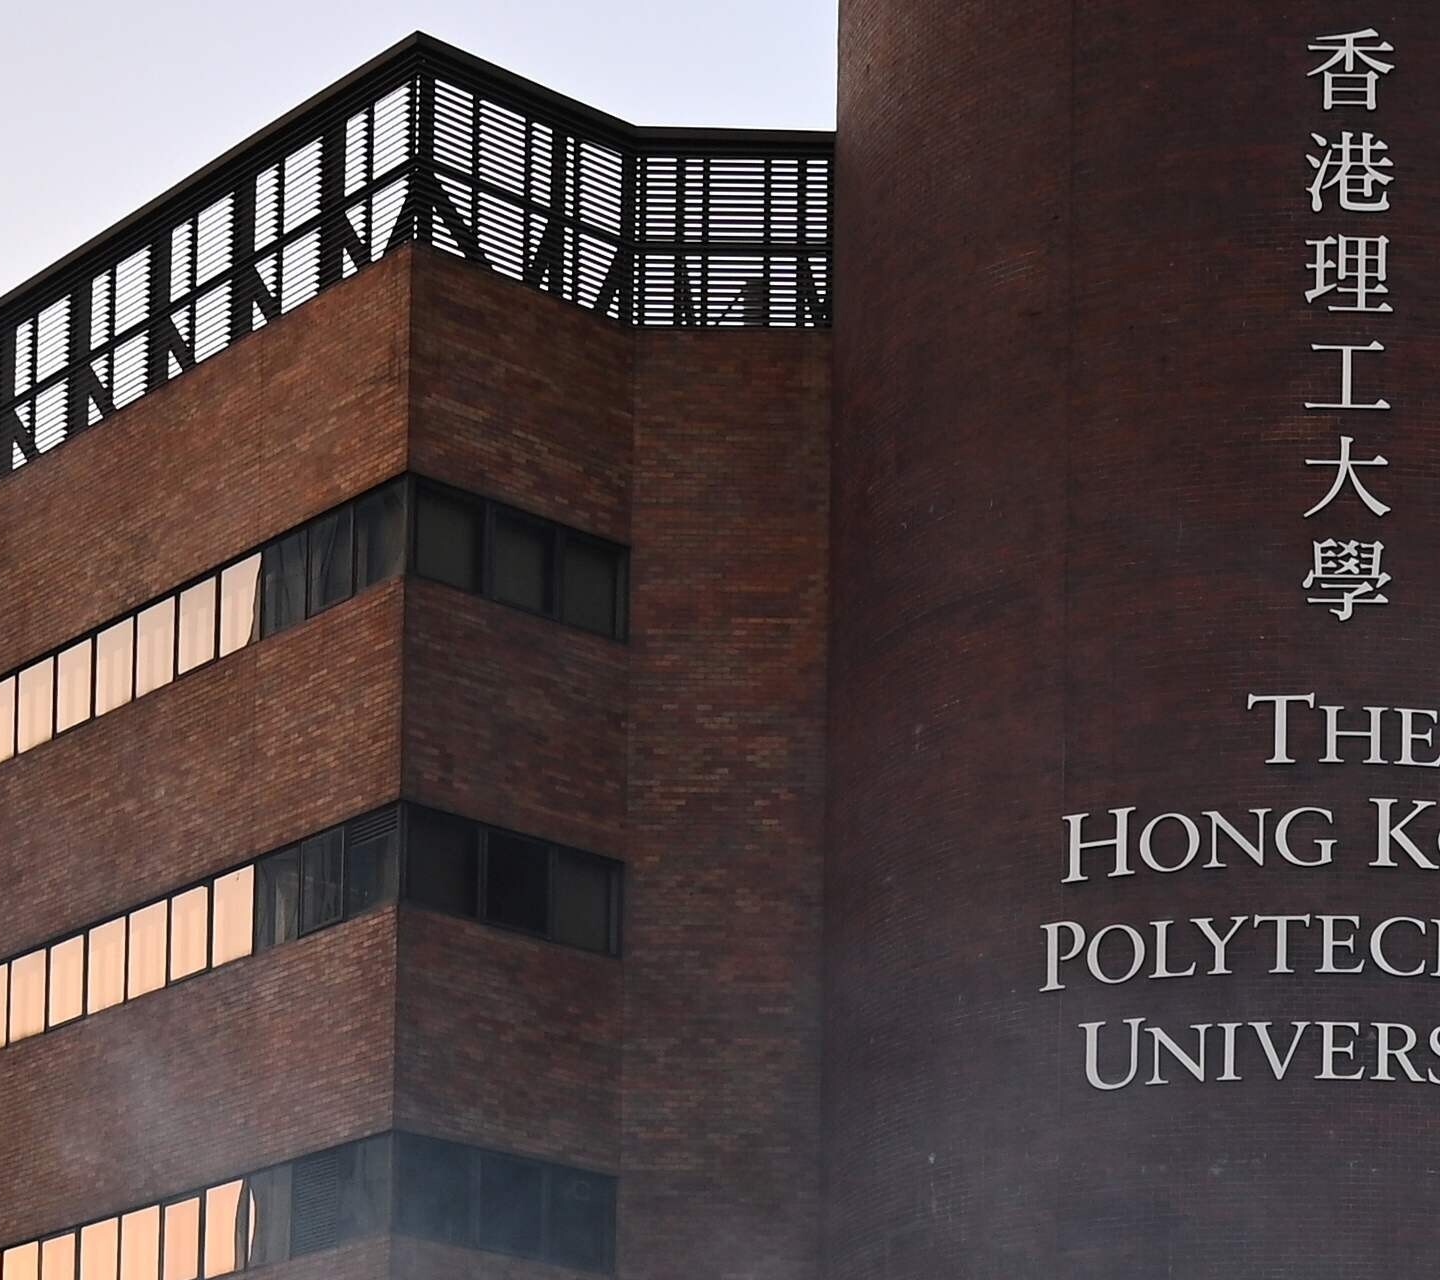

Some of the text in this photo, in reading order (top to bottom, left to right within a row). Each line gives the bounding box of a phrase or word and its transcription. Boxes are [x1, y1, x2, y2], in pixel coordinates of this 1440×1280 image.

[1302, 27, 1395, 621] 香港理工大學
[1061, 807, 1337, 883] HONG
